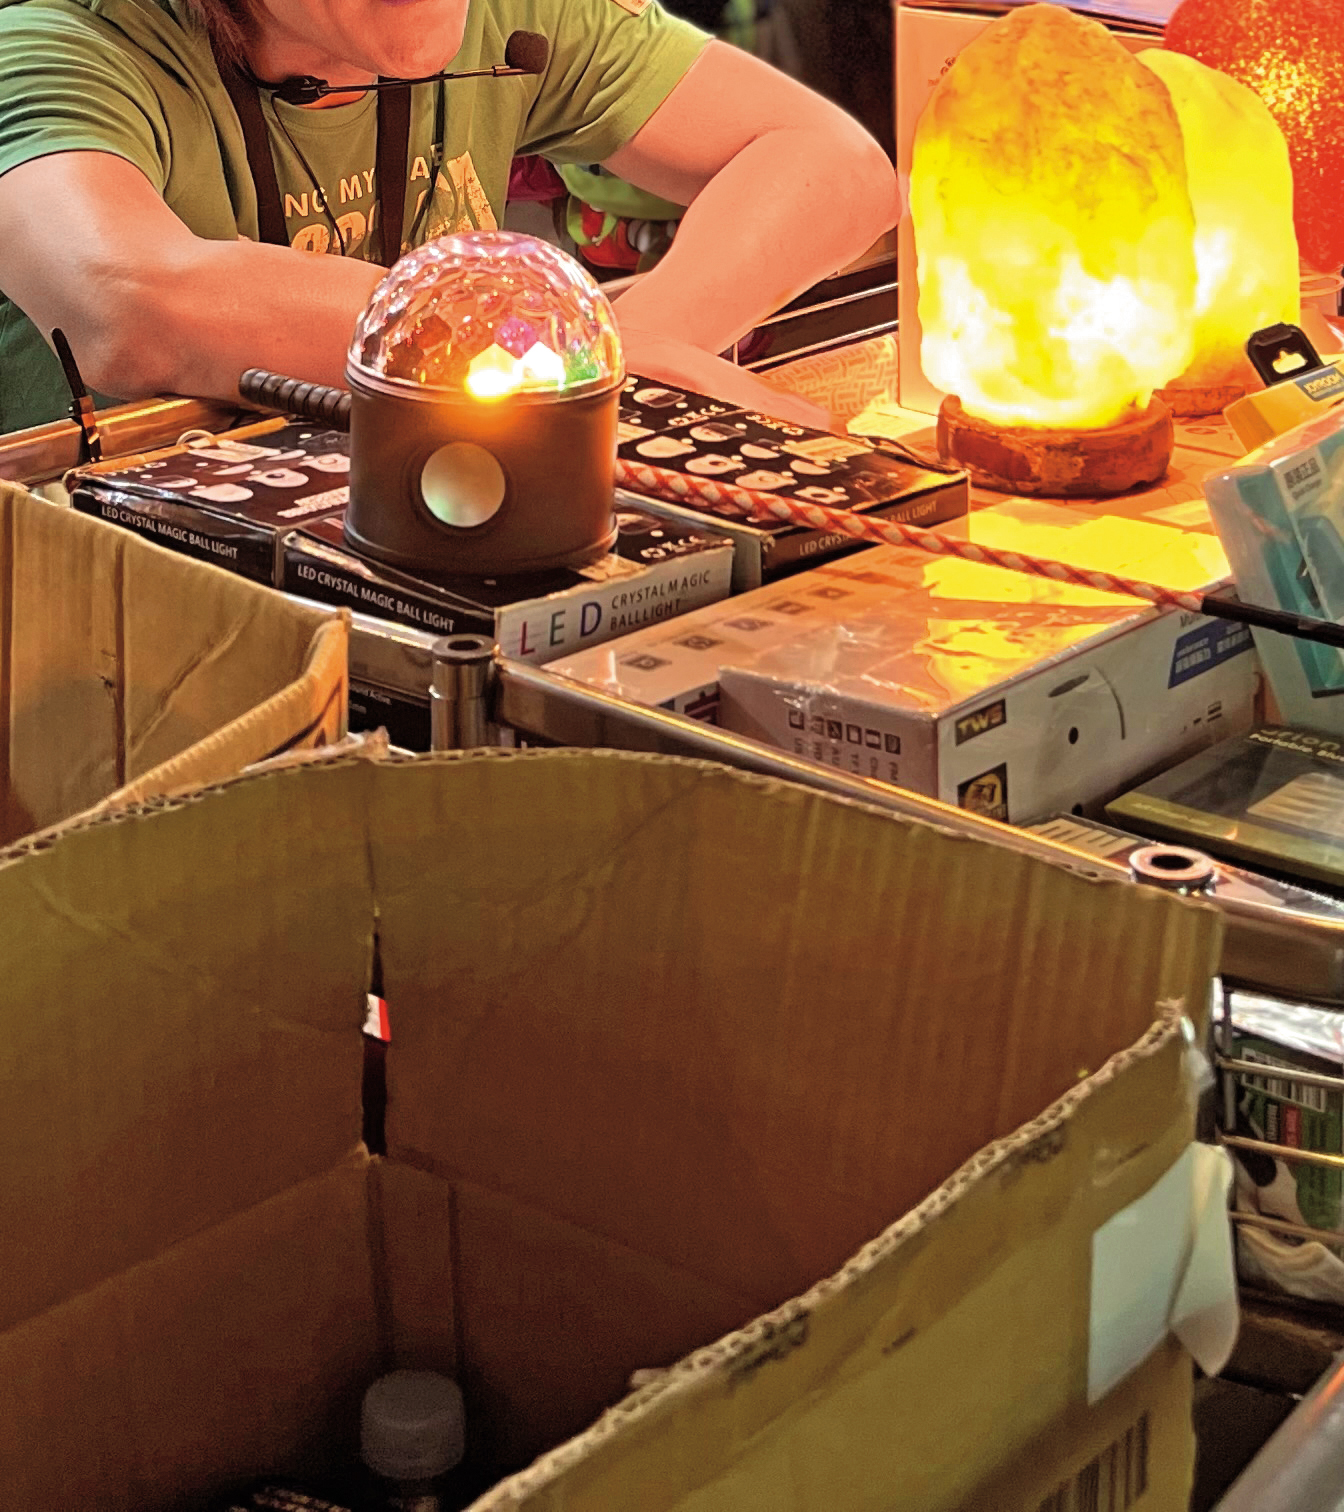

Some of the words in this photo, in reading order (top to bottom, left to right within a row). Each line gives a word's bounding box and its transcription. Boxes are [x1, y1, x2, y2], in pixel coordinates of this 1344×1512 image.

[101, 505, 119, 521] LED
[119, 508, 157, 532] CRYSTAL
[157, 521, 188, 544] MAGIC
[189, 531, 211, 551] BALL
[211, 540, 239, 560] LIGHT
[297, 563, 317, 581] LED
[317, 571, 359, 598] CRYSTAL
[360, 586, 395, 612] MAGIC
[396, 600, 421, 621] BALL
[422, 610, 455, 633] LIGHT
[519, 601, 603, 657] LED
[958, 703, 1004, 736] TWS
